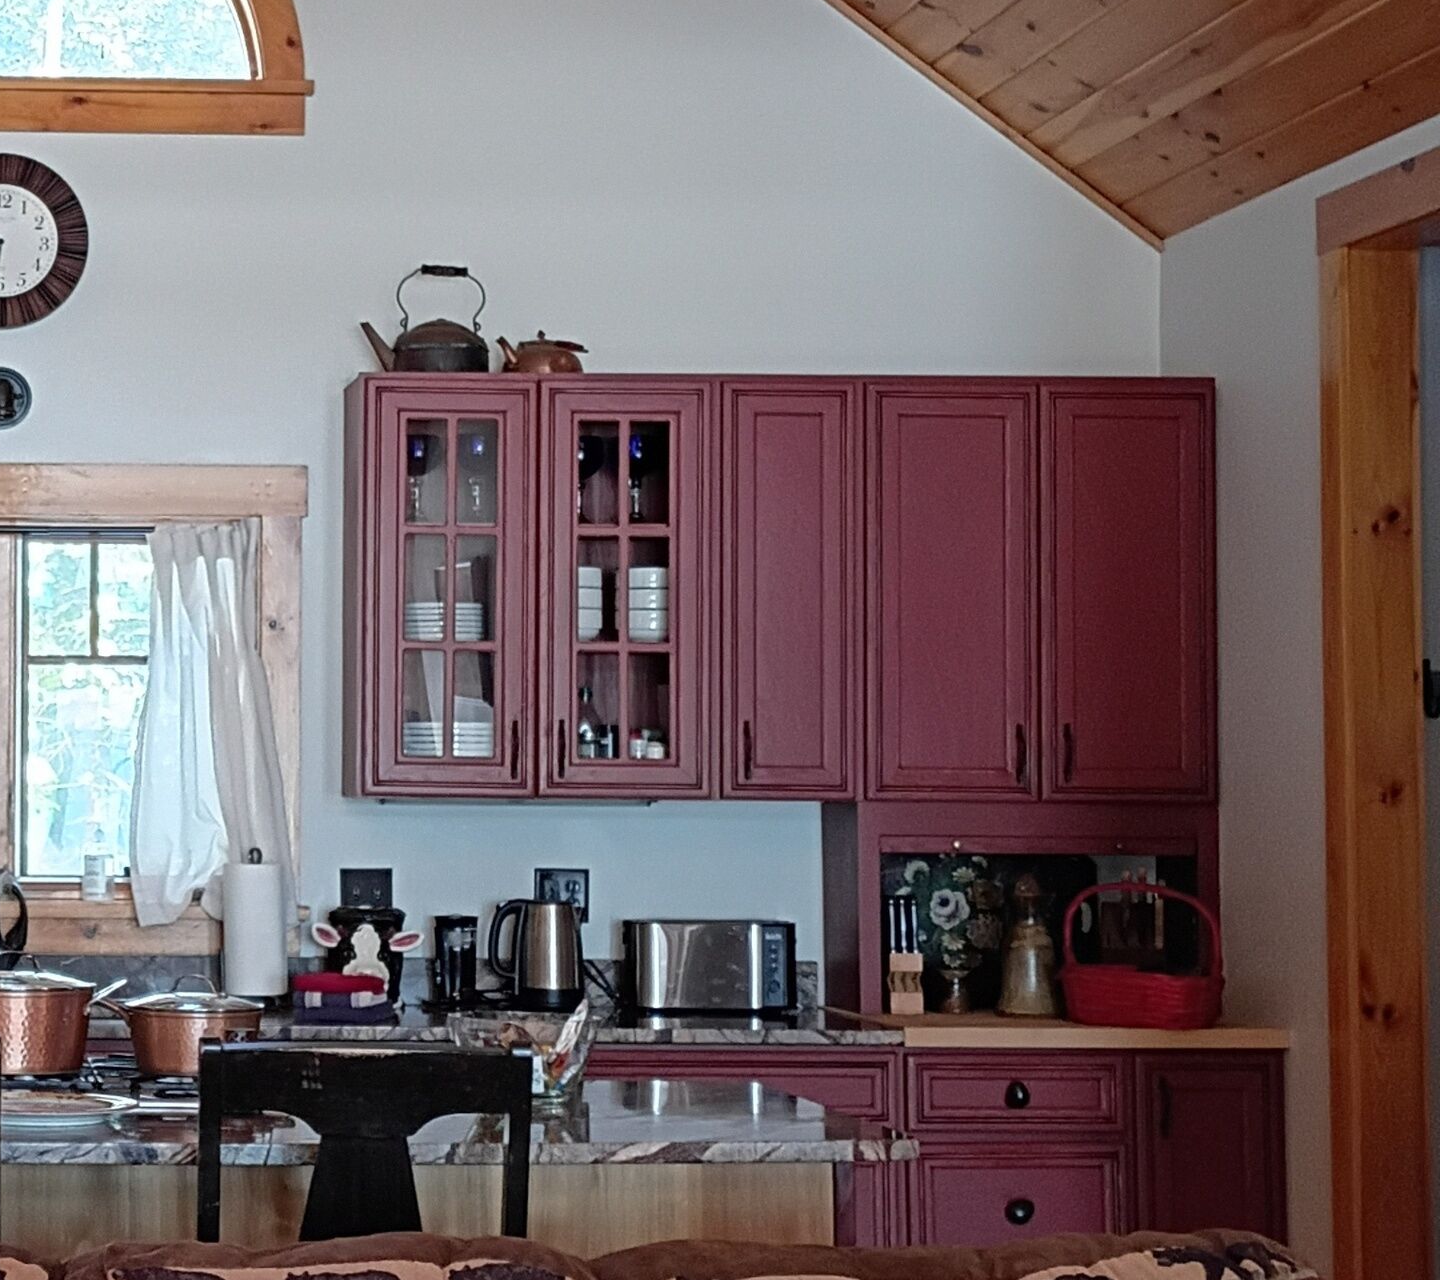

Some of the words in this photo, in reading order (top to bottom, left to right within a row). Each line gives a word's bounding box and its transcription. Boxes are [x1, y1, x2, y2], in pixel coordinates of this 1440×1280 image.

[21, 200, 27, 215] 1
[34, 215, 45, 230] 2
[39, 236, 49, 251] 3
[16, 272, 27, 287] 5
